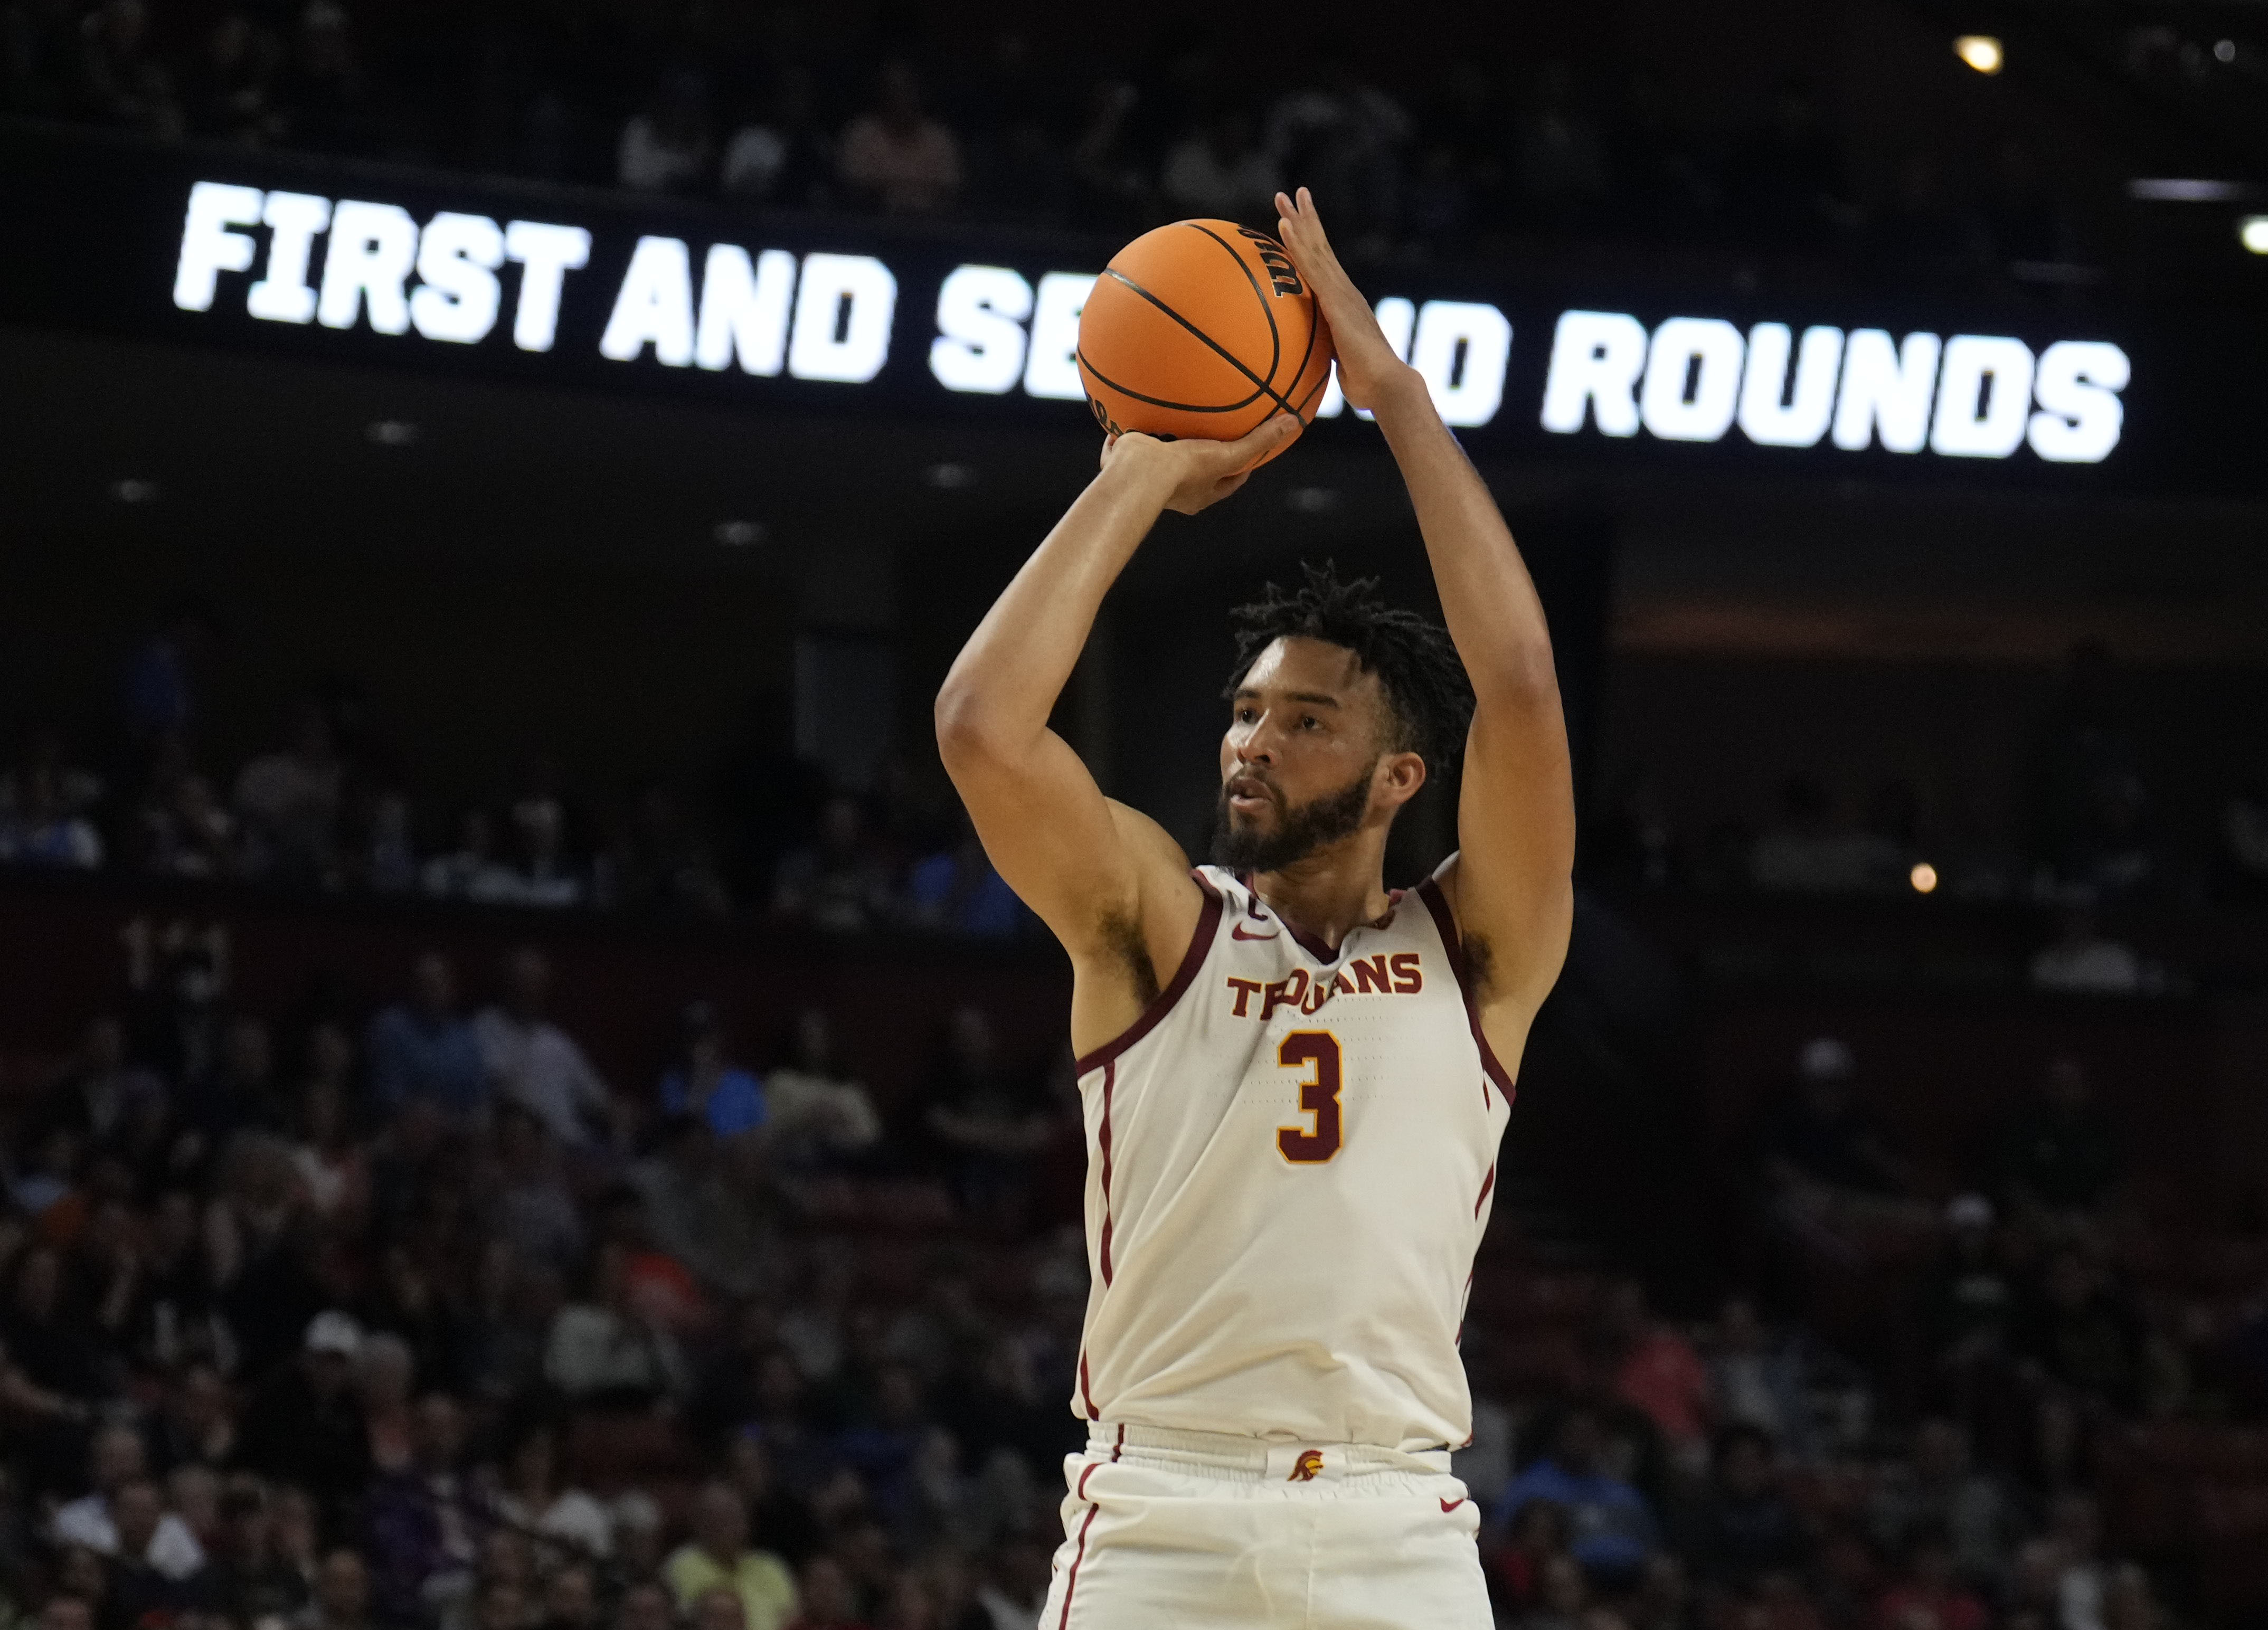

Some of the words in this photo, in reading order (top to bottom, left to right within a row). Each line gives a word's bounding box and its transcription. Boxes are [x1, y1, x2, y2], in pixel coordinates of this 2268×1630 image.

[172, 180, 592, 353] FIRST
[600, 235, 898, 384] AND
[928, 263, 1514, 429] SED
[1540, 309, 2131, 463] ROUNDS
[1227, 953, 1423, 1021] TROJANS
[1277, 1029, 1343, 1164] 3
